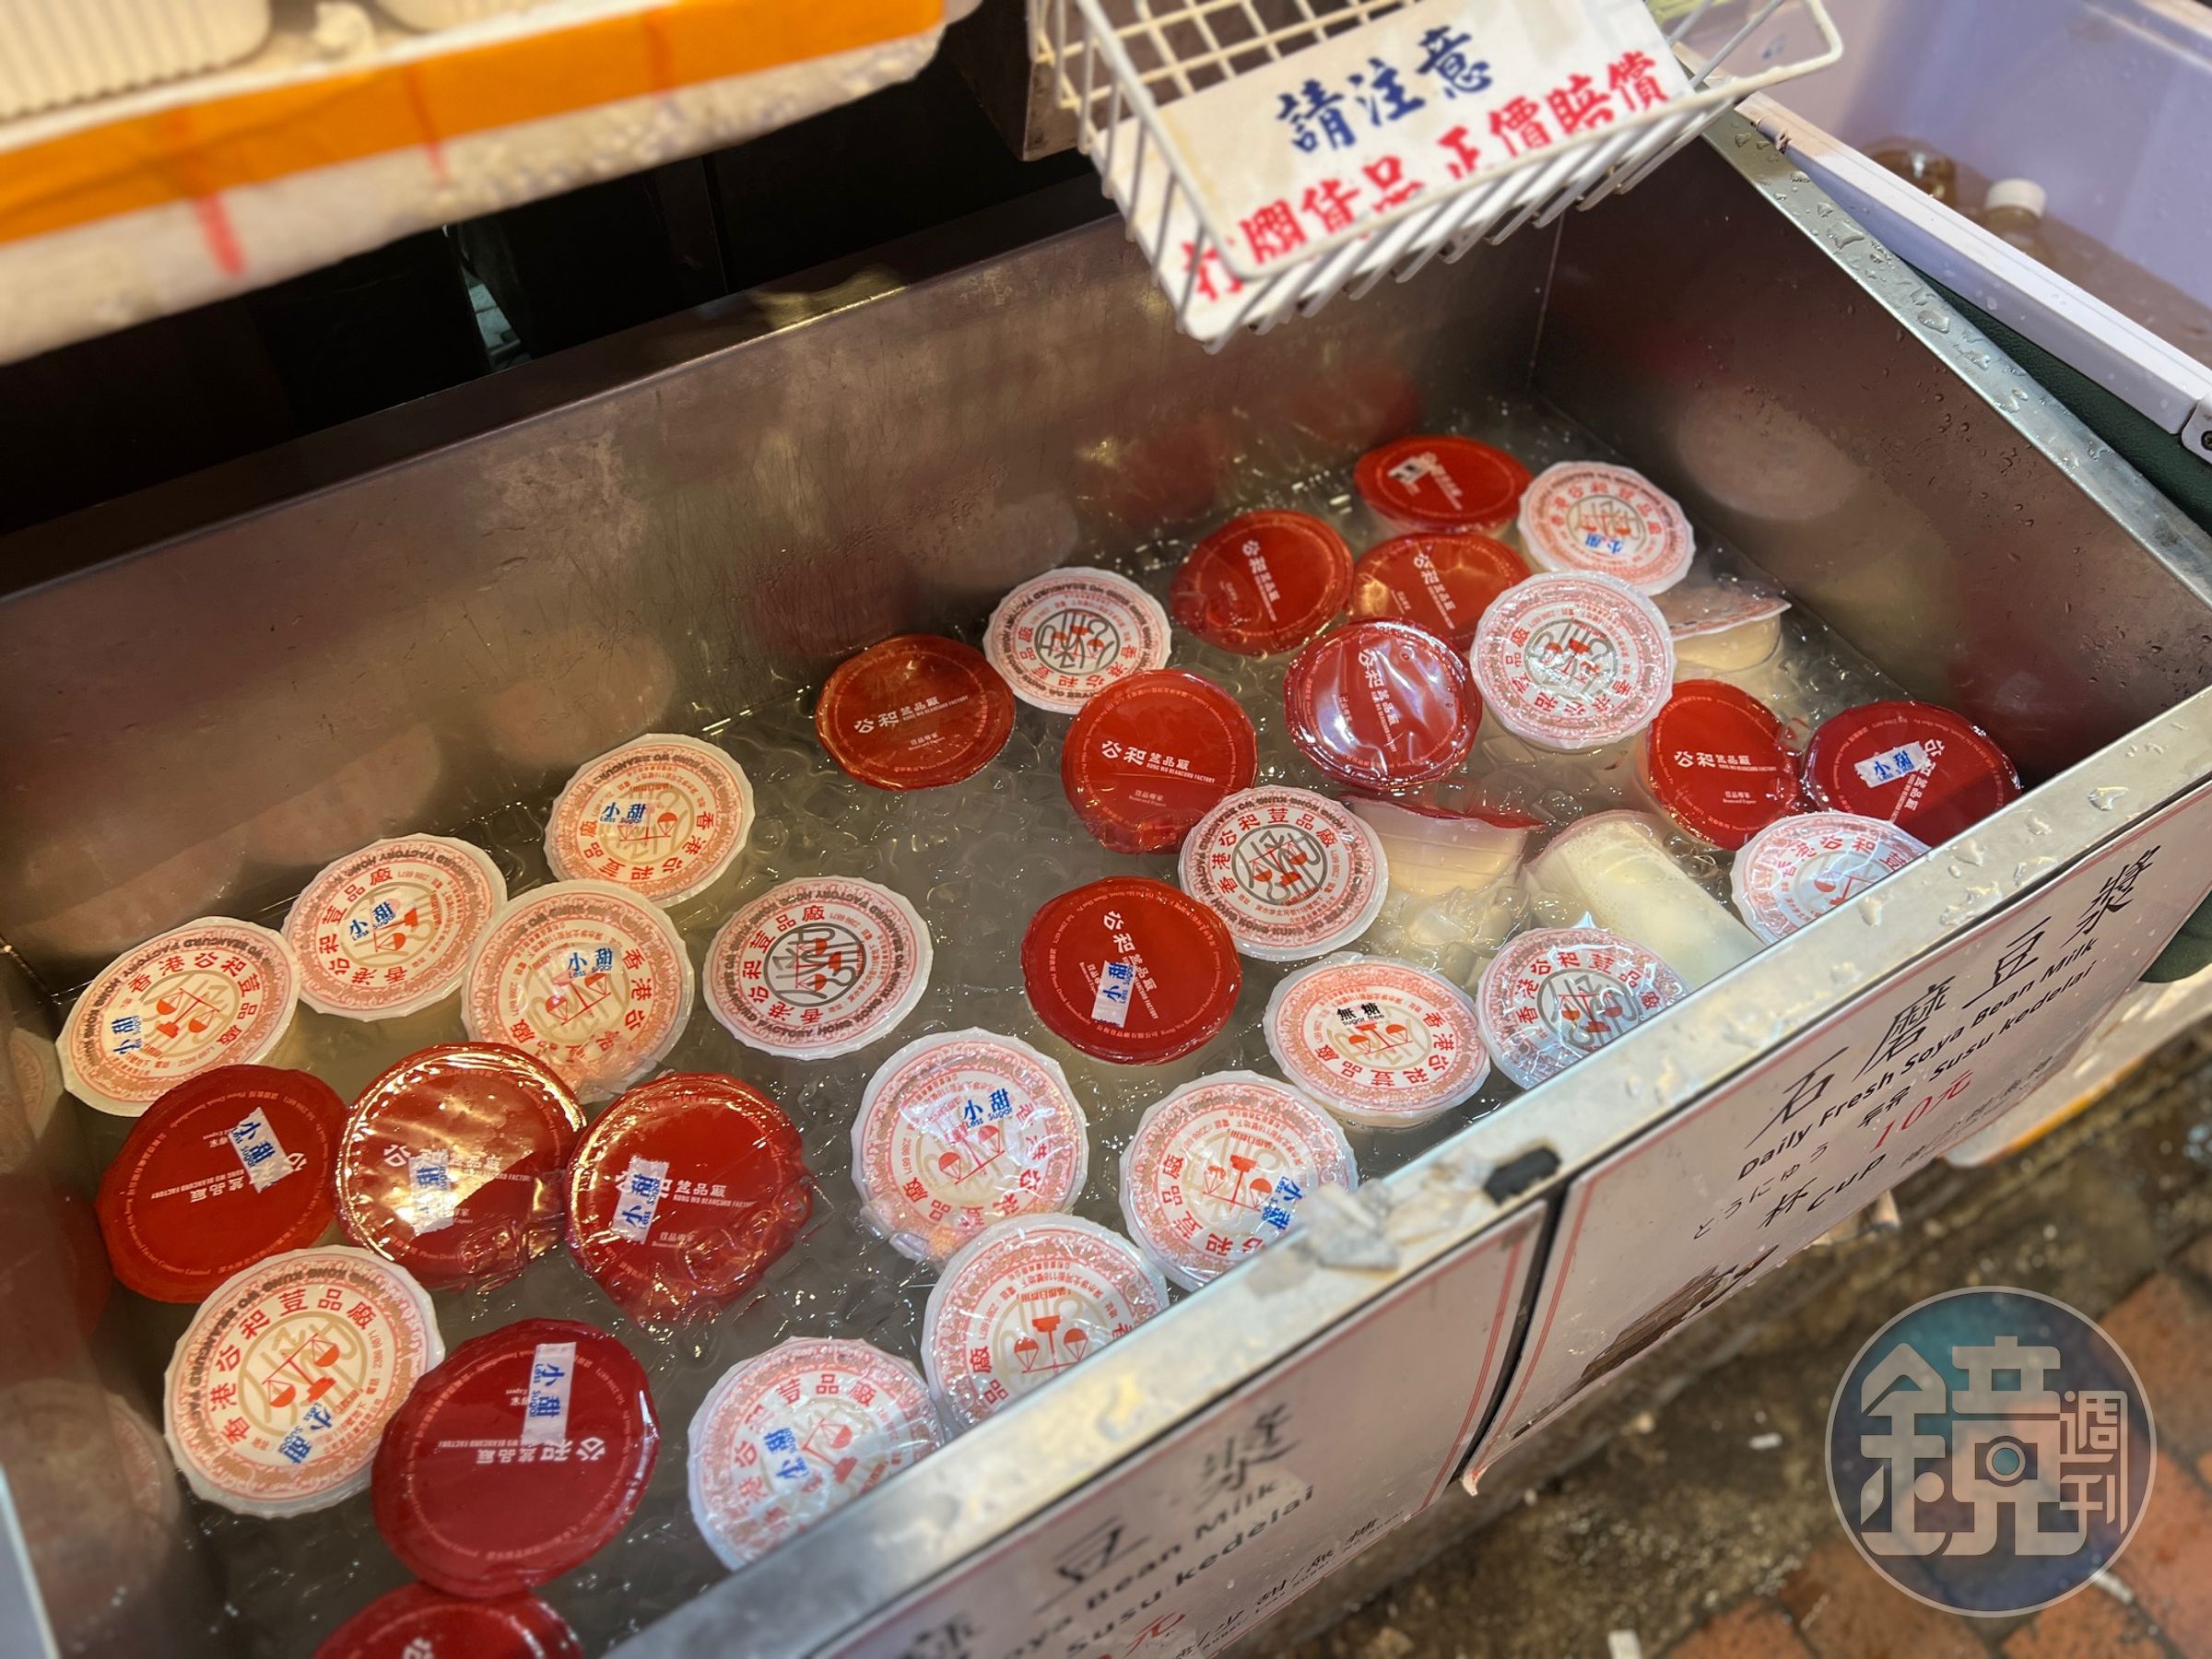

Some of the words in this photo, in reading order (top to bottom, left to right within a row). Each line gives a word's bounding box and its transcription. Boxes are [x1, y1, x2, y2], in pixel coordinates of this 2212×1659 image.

[1277, 24, 1494, 155] 請注意
[1211, 807, 1338, 894] 香港公和荳品廠
[348, 900, 395, 935] 小甜
[568, 947, 614, 971] 小甜
[742, 905, 826, 1025] 香港公和荳品廠
[1336, 1001, 1382, 1022] 無糖
[1998, 960, 2098, 1036] kedelai
[1736, 1122, 1812, 1181] Daily
[1818, 1070, 1894, 1129] Fresh
[1900, 1025, 1965, 1076] Soya
[1970, 980, 2036, 1029] Bean
[2039, 936, 2100, 982] Milk
[962, 1087, 1012, 1122] 小甜
[622, 1173, 653, 1229] 小甜
[210, 1288, 377, 1445] 香港公和荳品廠
[536, 1362, 565, 1418] 小甜
[284, 1406, 334, 1465] 小甜
[1174, 1483, 1315, 1588] kedelai
